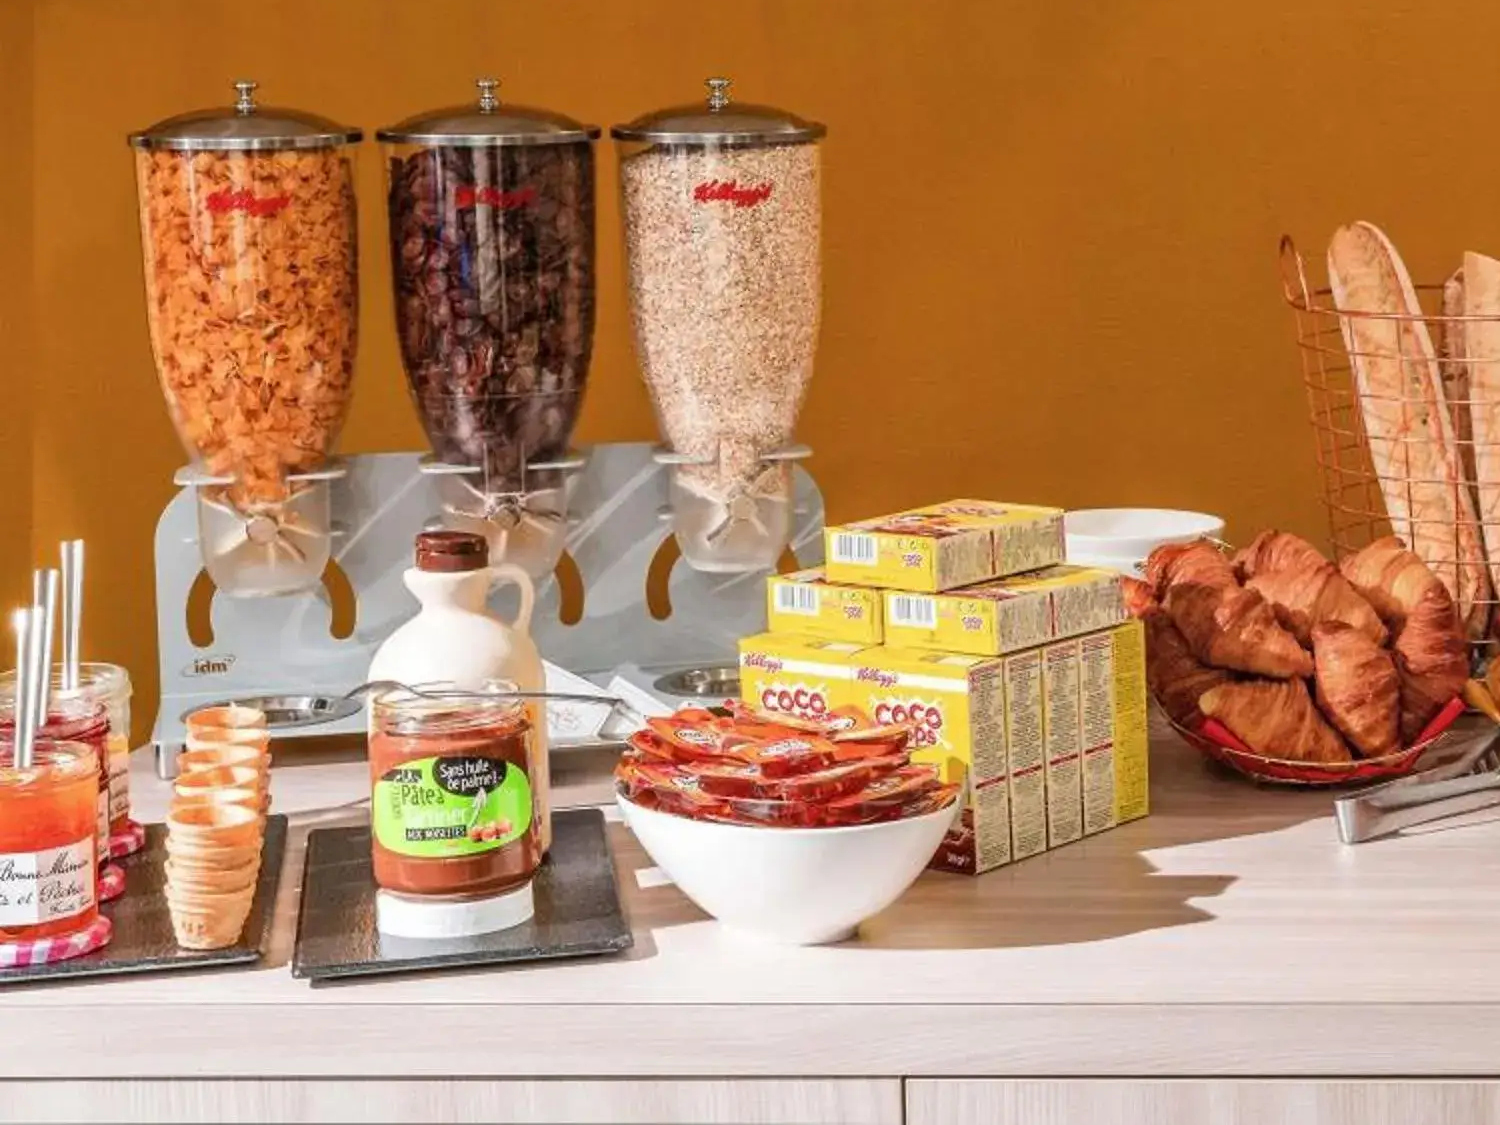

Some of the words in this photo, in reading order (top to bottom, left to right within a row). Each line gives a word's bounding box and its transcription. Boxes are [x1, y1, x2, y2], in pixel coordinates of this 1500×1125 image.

[744, 653, 783, 673] Kellogg's
[857, 667, 899, 687] Kellogg's
[762, 687, 826, 712] COCO
[875, 702, 943, 729] COCO
[440, 763, 464, 777] Sans
[401, 784, 435, 806] Pâte
